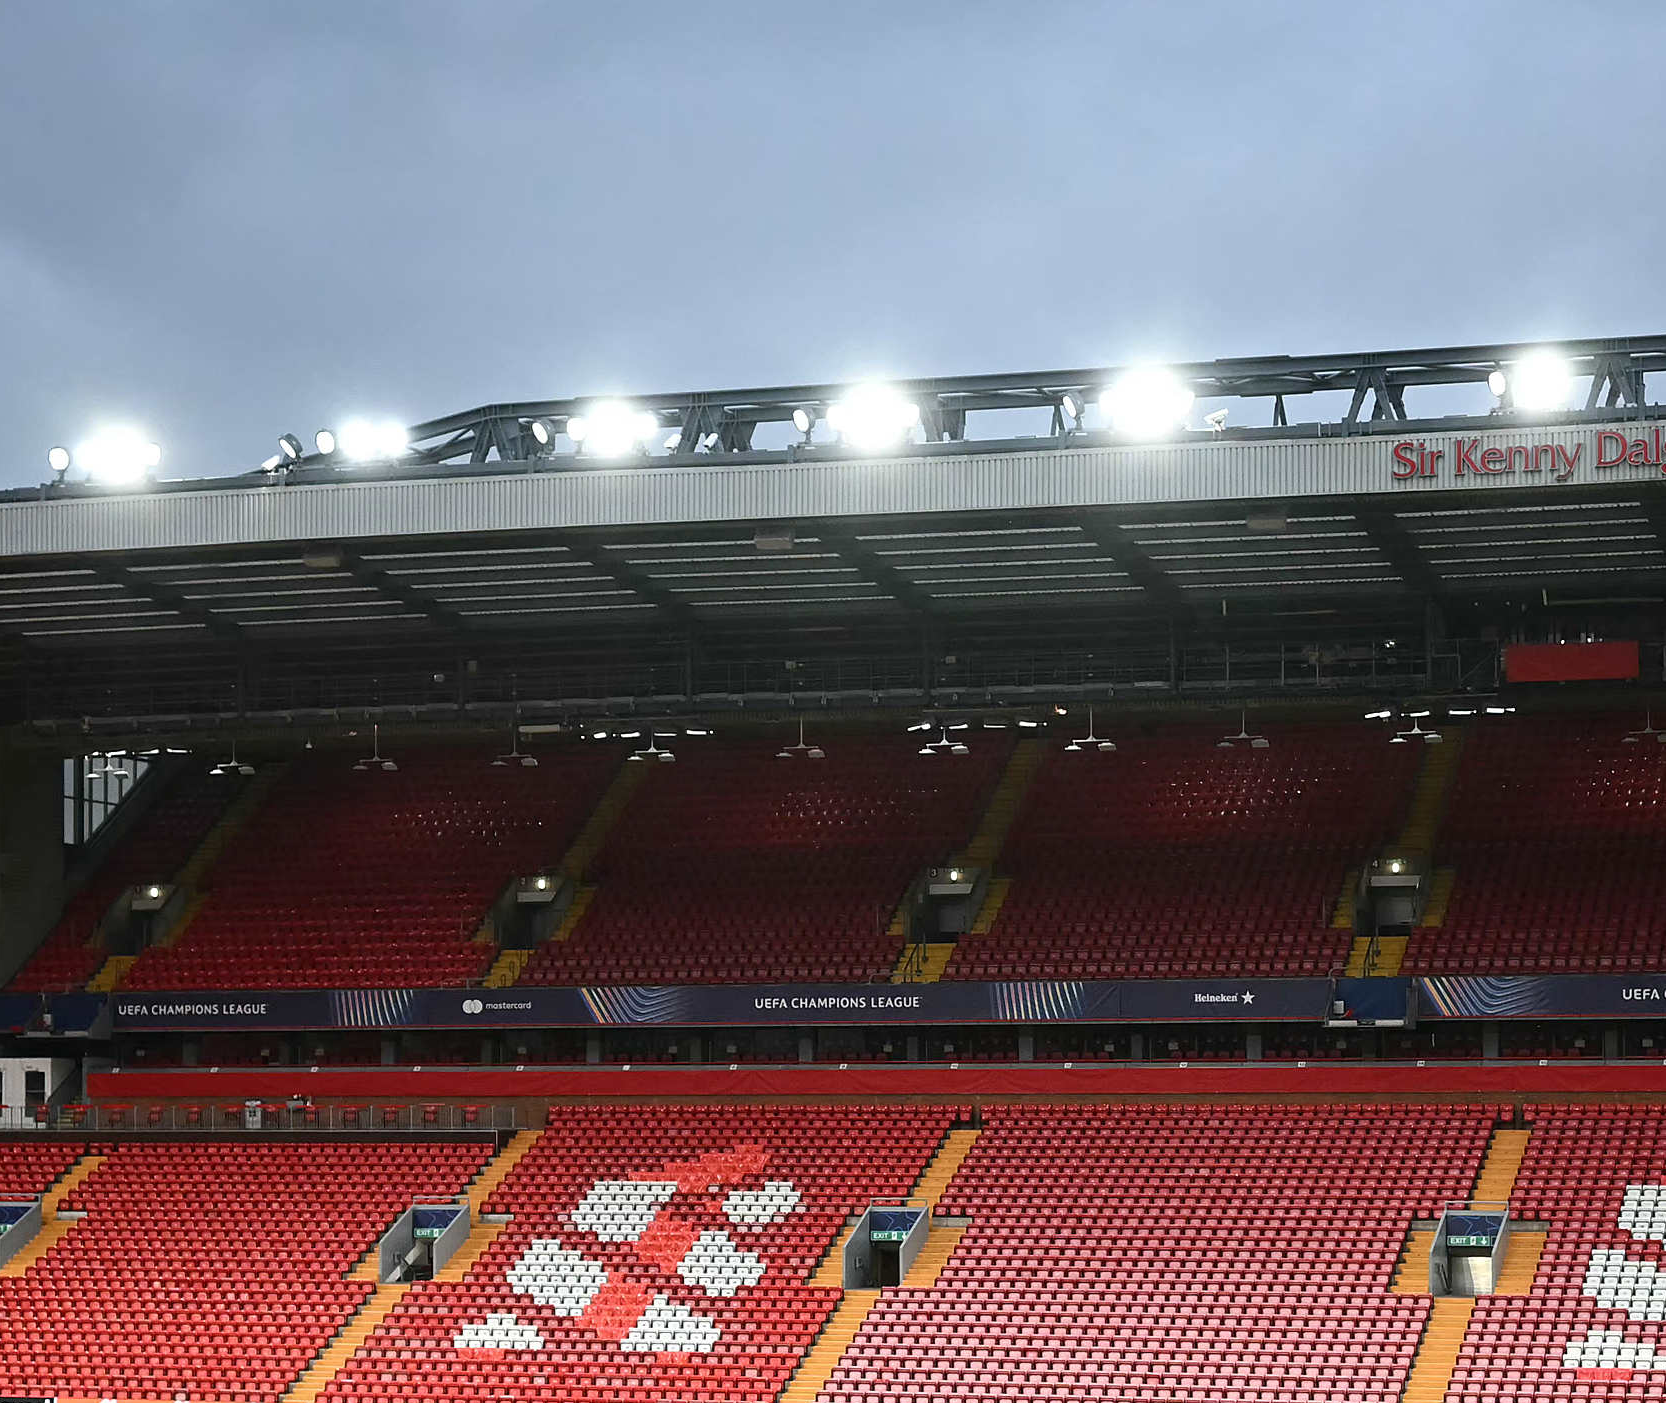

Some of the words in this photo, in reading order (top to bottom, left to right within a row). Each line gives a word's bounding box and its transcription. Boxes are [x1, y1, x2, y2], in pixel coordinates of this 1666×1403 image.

[1392, 441, 1444, 479] Sir
[1453, 437, 1583, 480] Kenny
[1194, 993, 1238, 1003] Heineken
[1623, 989, 1660, 999] UEFA
[486, 1001, 531, 1010] mastercard
[755, 998, 787, 1008] UEFA
[792, 997, 866, 1008] CHAMPIONS
[872, 996, 919, 1007] LEAGUE
[119, 1005, 149, 1015] UEFA
[152, 1004, 219, 1014] CHAMPIONS
[222, 1003, 266, 1014] LEAGUE
